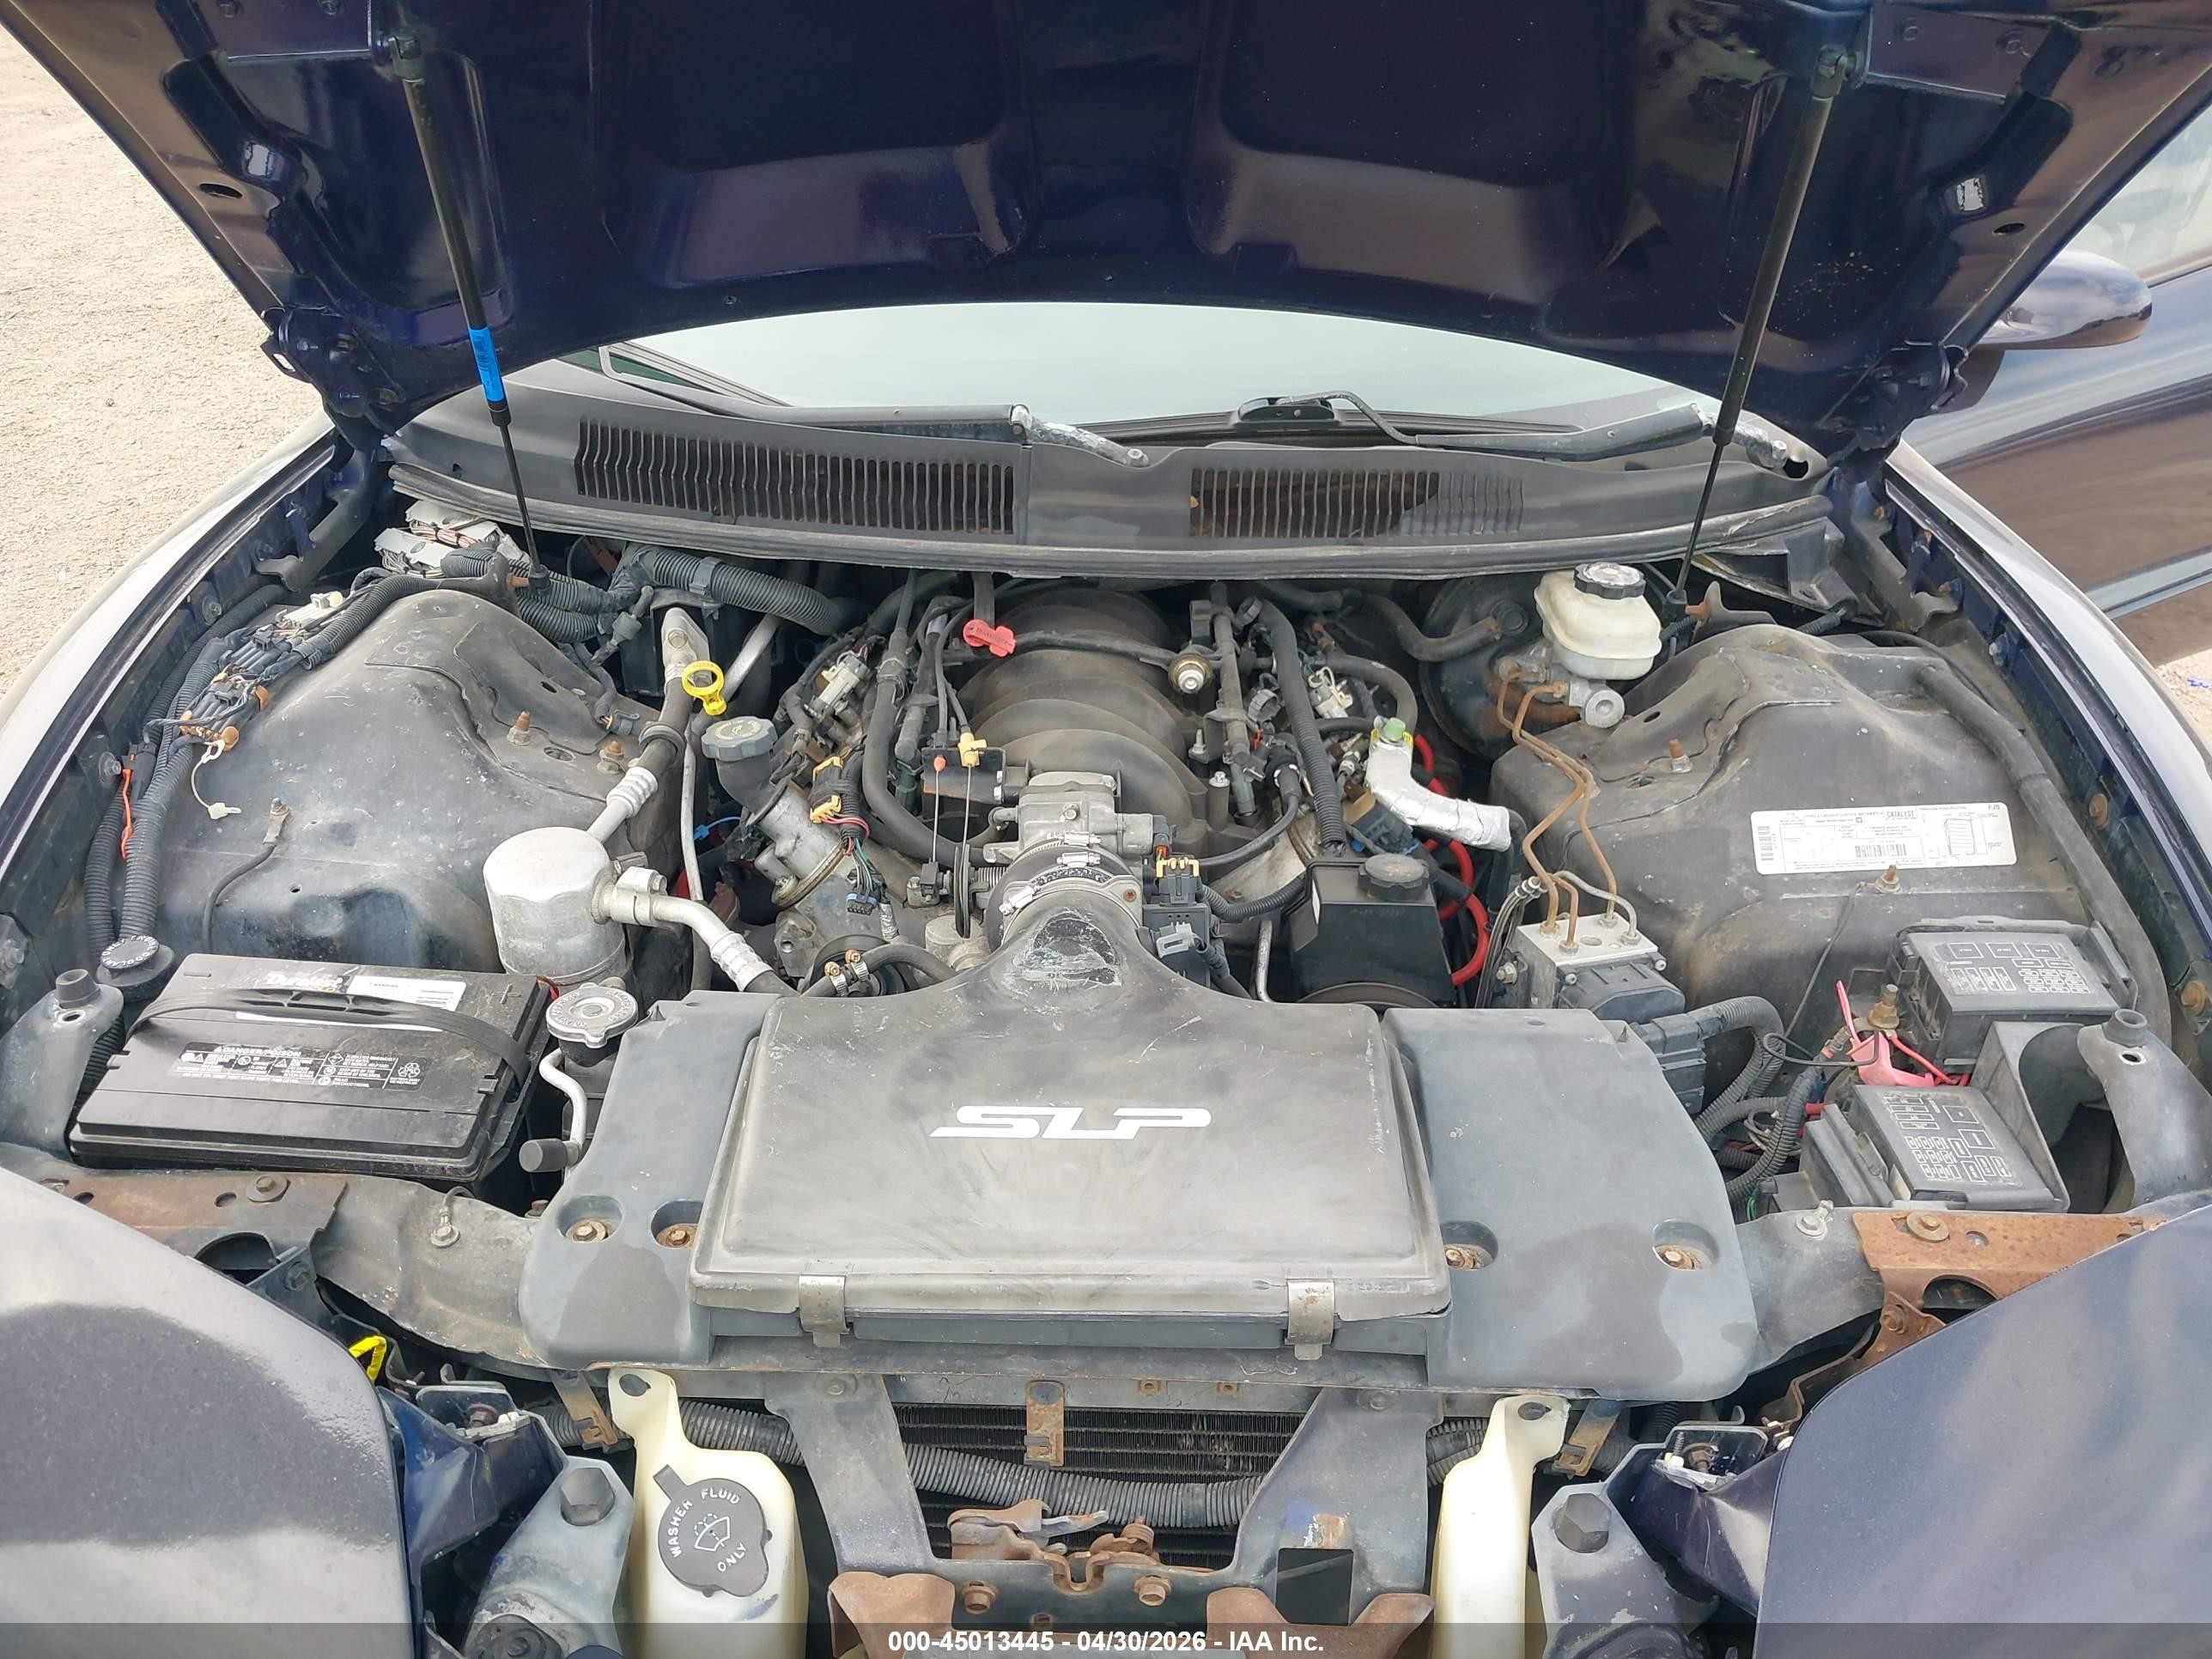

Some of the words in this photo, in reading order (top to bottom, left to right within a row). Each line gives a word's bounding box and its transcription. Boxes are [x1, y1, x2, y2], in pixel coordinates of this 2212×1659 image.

[929, 1104, 1212, 1140] SLP
[700, 1488, 740, 1504] FLUID
[666, 1499, 693, 1559] WASHER
[716, 1542, 747, 1573] ONLY
